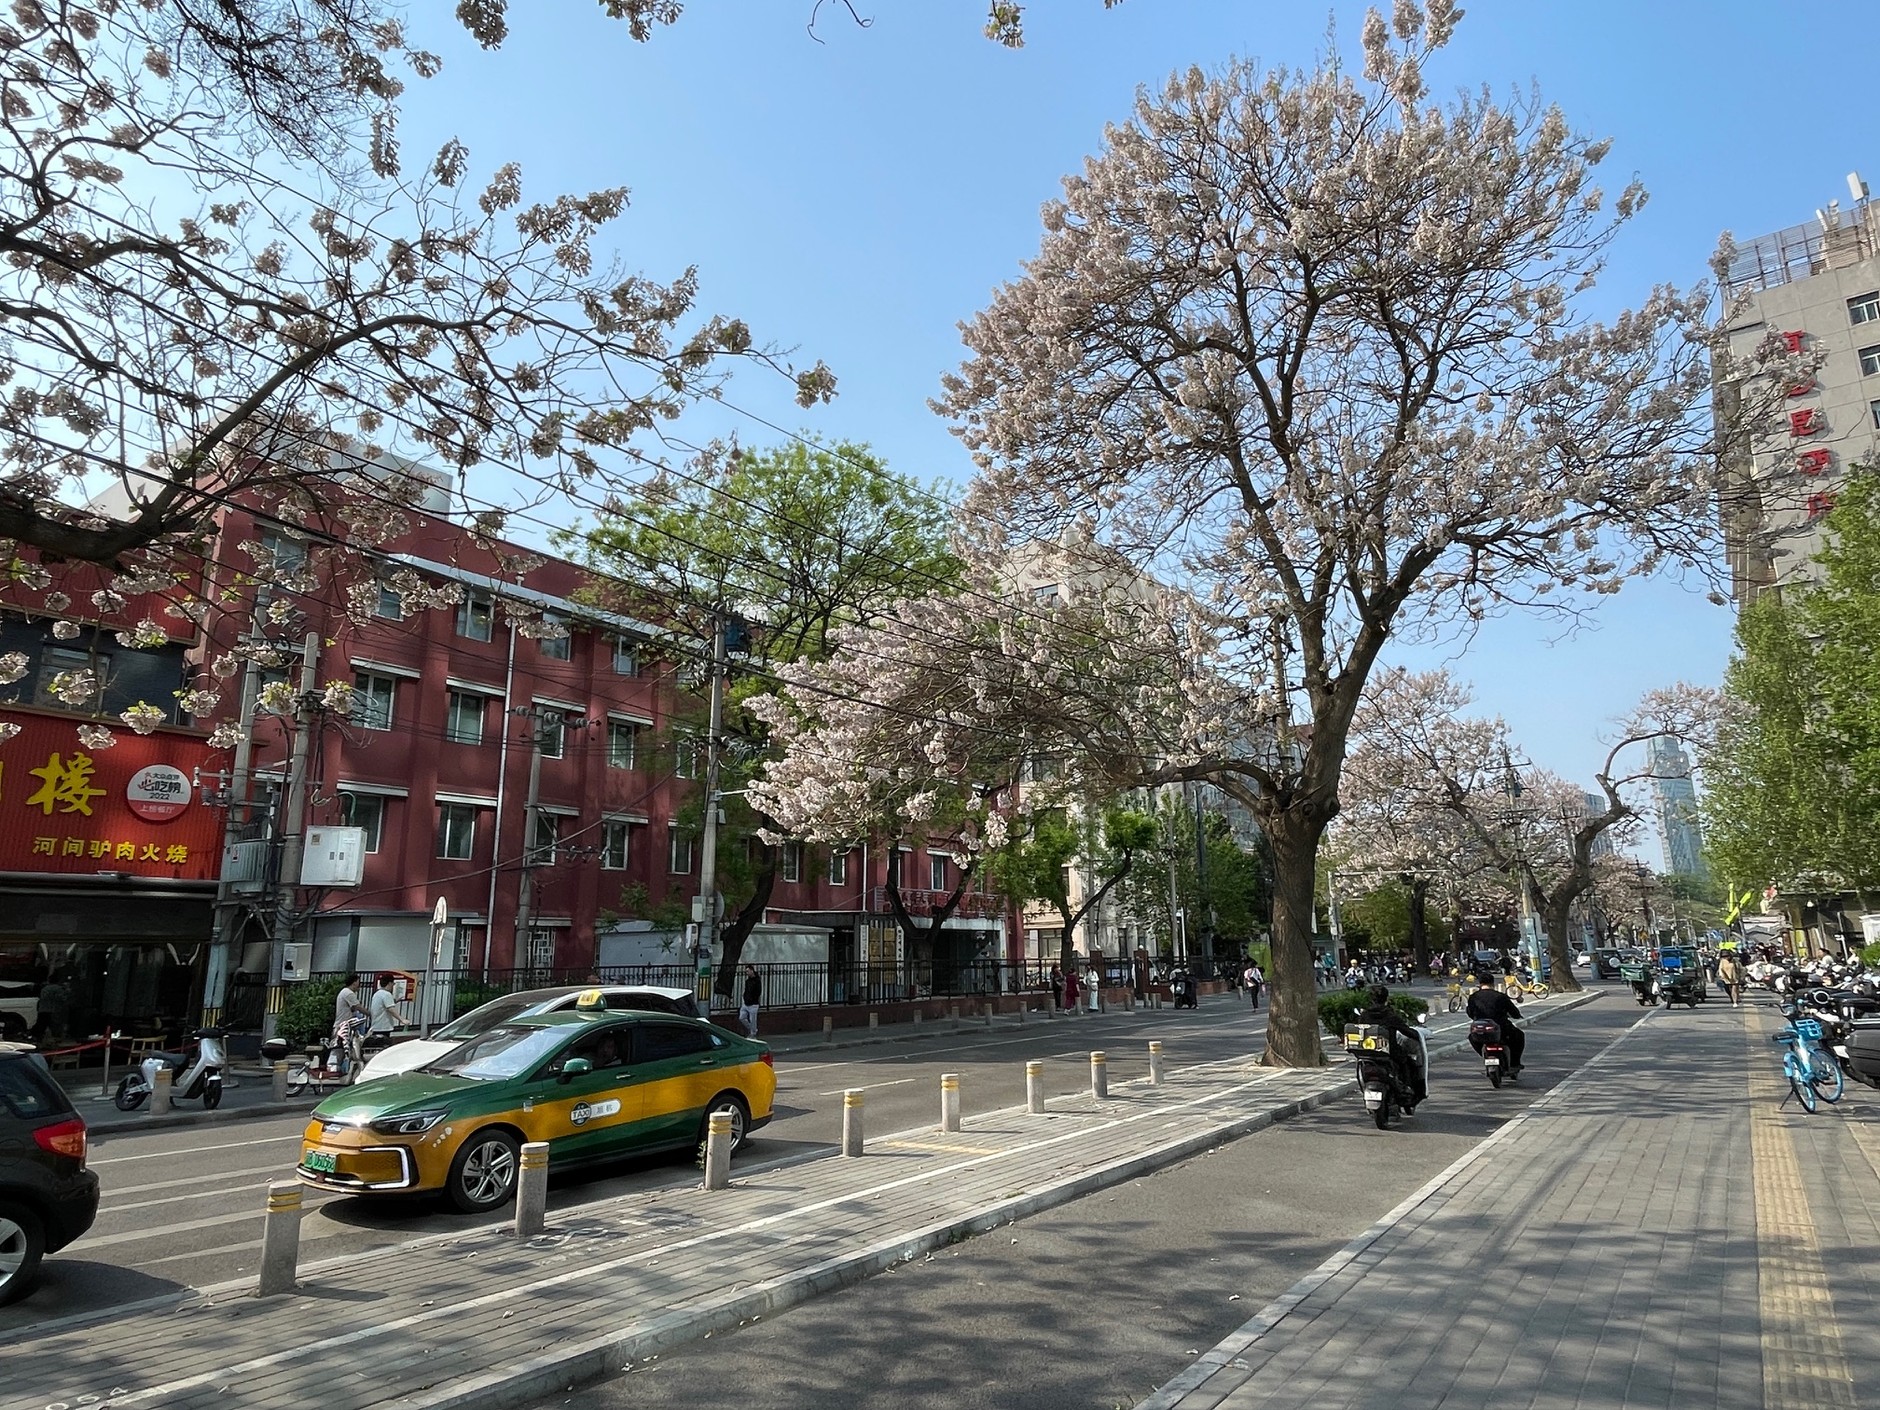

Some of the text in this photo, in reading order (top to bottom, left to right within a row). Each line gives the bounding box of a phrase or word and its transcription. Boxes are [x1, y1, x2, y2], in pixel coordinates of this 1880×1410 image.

[0, 751, 107, 816] 楼
[137, 779, 181, 794] 必吃榜
[32, 836, 188, 864] 河间驴肉火烧
[572, 1109, 590, 1119] TAXI
